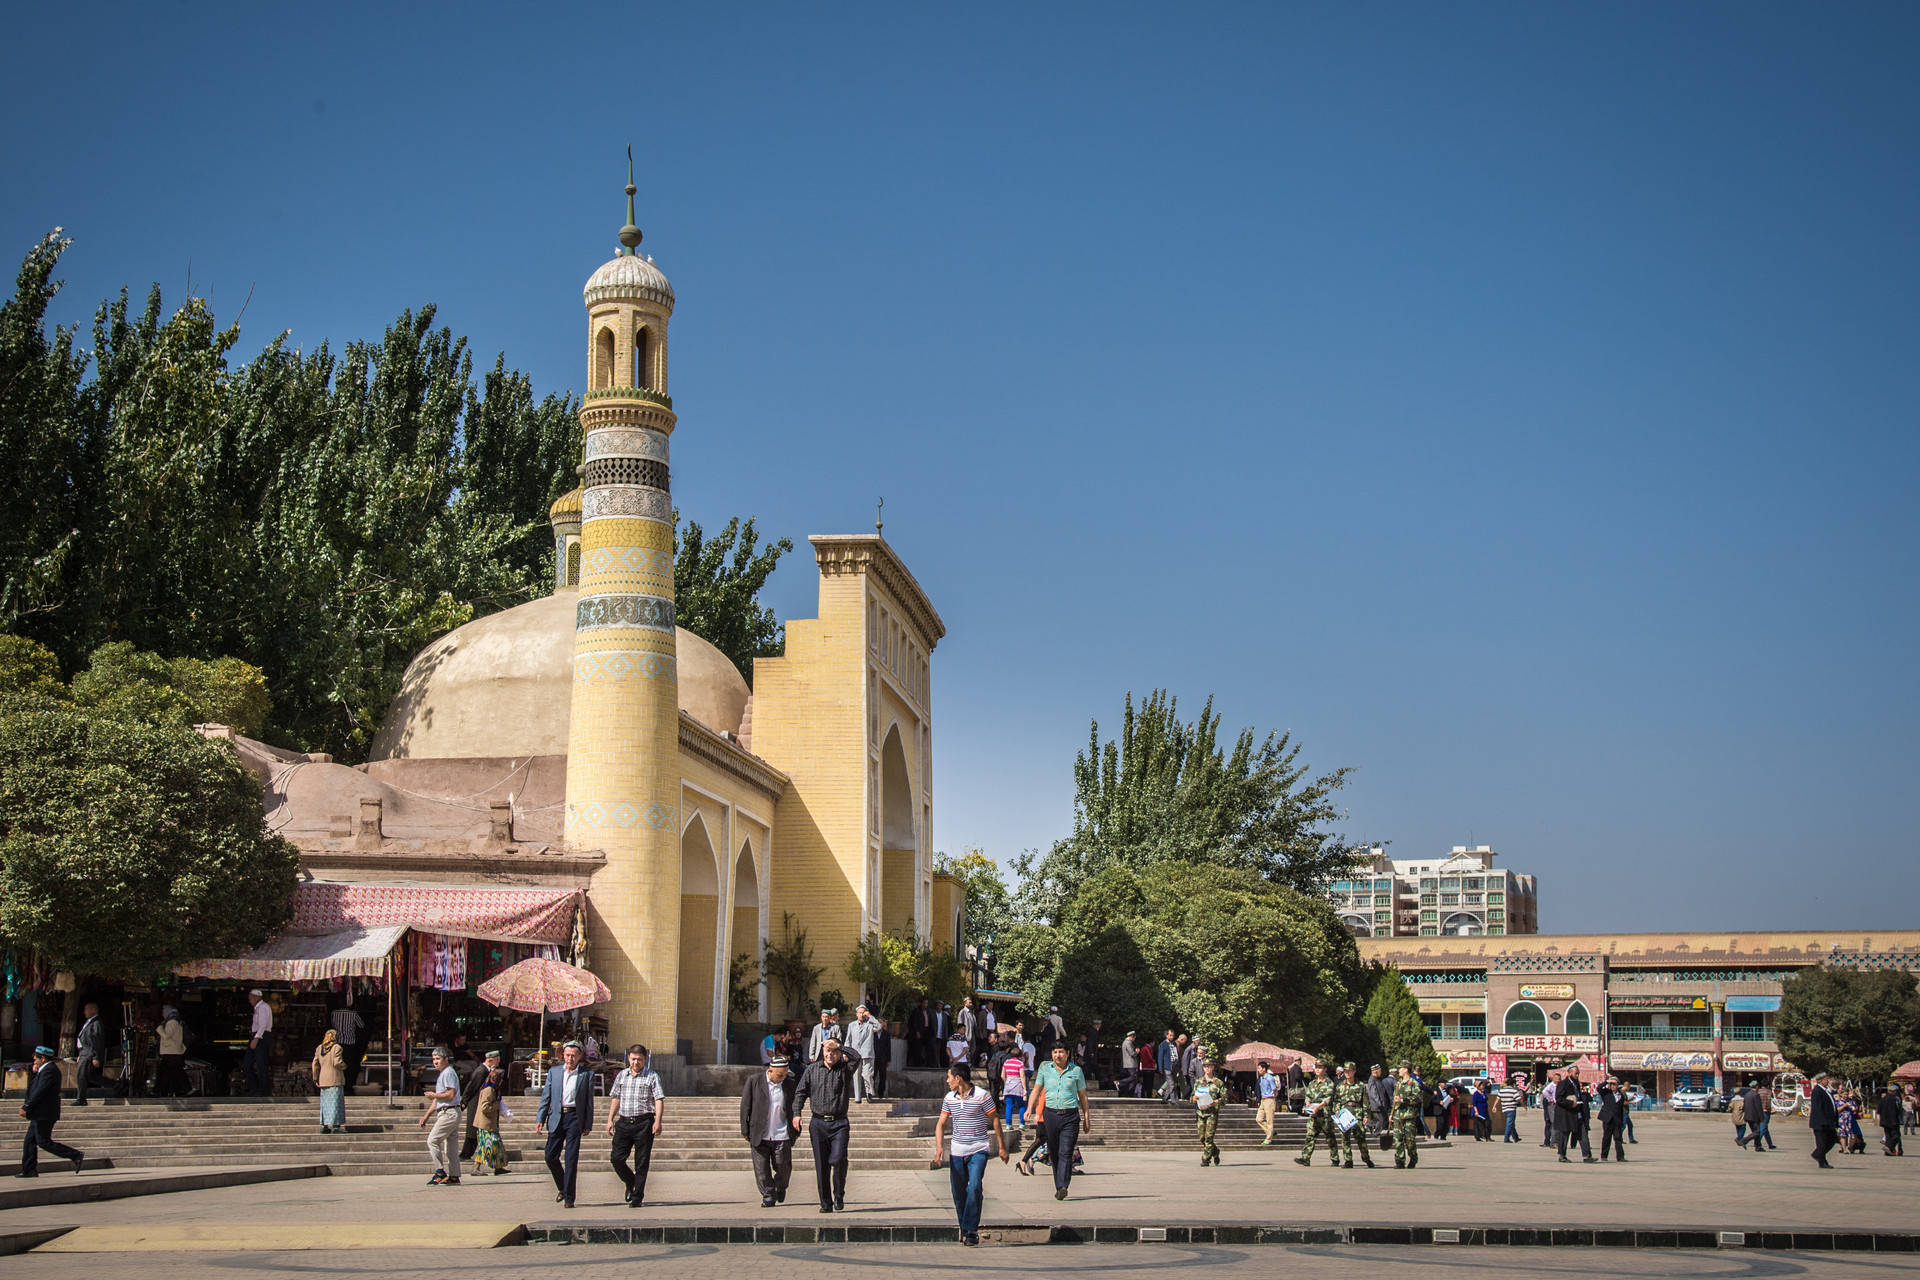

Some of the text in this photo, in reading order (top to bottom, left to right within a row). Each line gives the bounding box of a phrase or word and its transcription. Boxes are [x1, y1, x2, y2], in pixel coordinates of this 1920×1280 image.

[1512, 1036, 1574, 1051] 和田玉籽料
